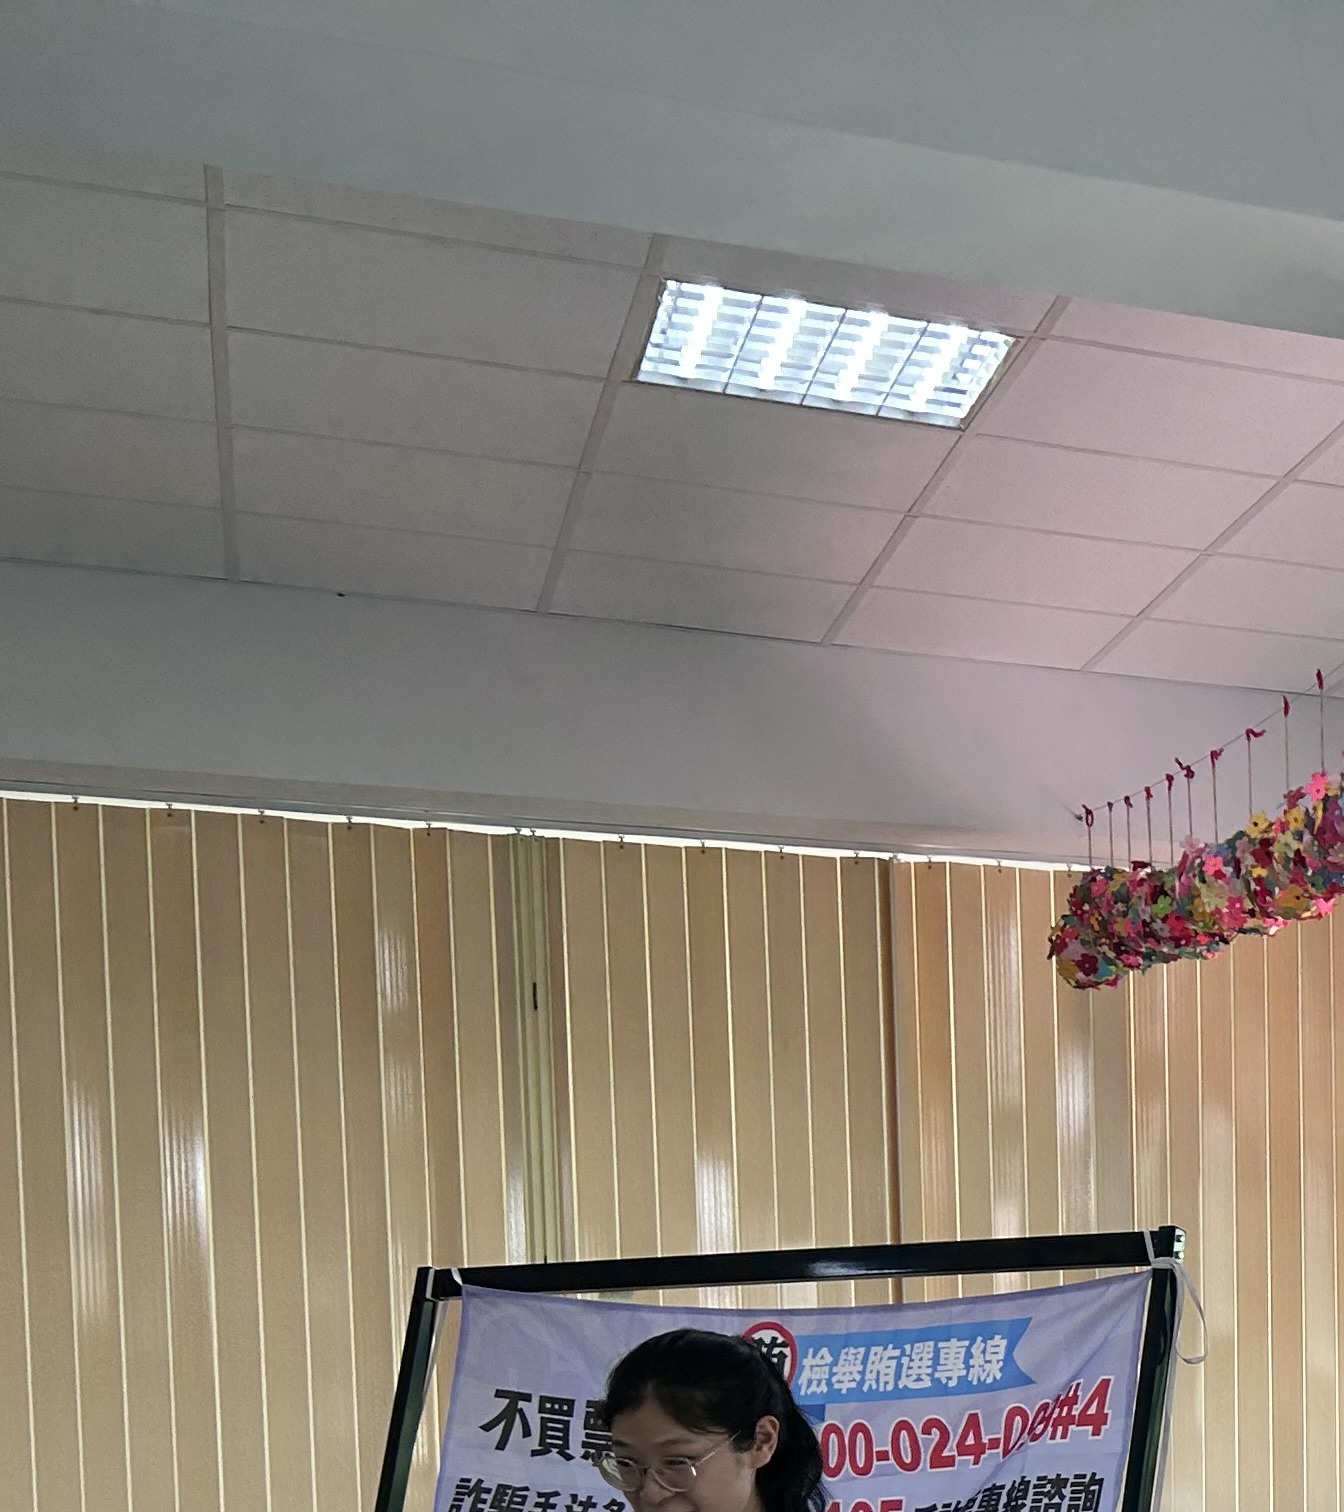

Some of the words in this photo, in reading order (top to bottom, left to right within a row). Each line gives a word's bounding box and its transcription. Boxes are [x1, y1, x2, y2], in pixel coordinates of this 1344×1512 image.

[798, 1335, 1008, 1396] 檢舉賄選專線
